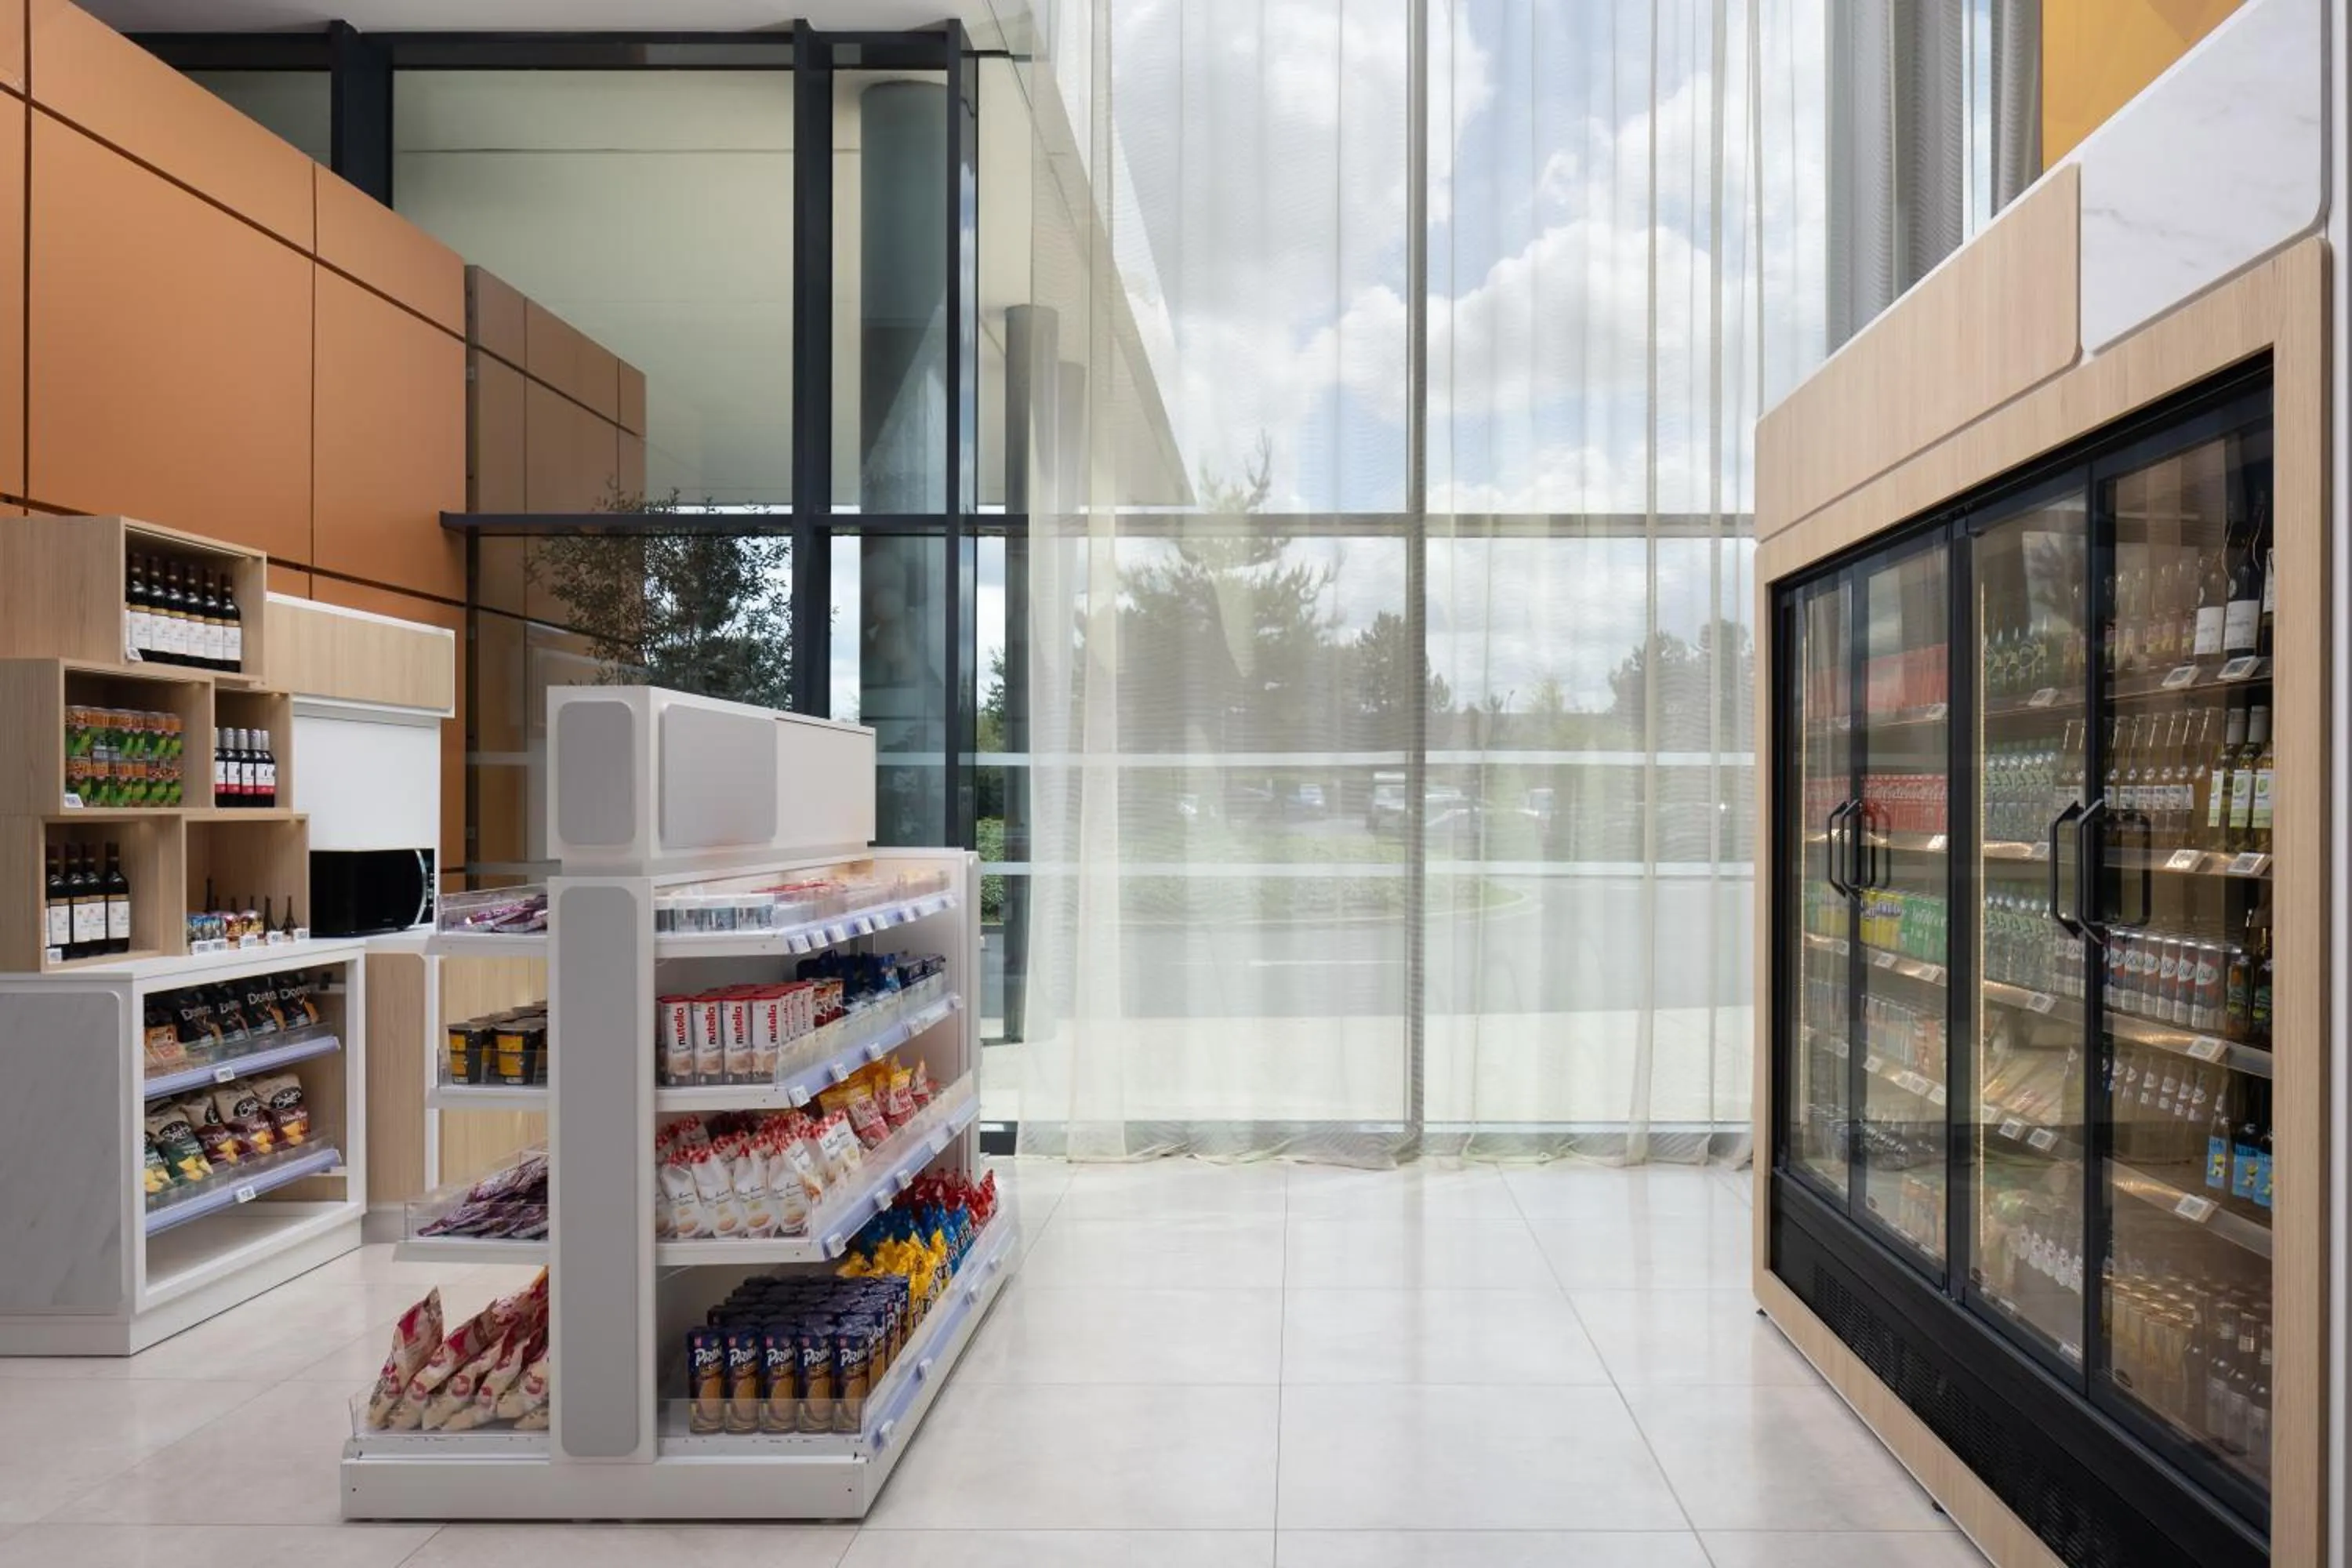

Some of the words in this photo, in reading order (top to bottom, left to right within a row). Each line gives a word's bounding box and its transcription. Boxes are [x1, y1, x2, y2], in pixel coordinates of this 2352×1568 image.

[674, 1007, 686, 1046] nutella
[705, 1006, 717, 1045] nutella
[732, 1006, 744, 1044] nutella
[768, 1004, 778, 1043] nutella
